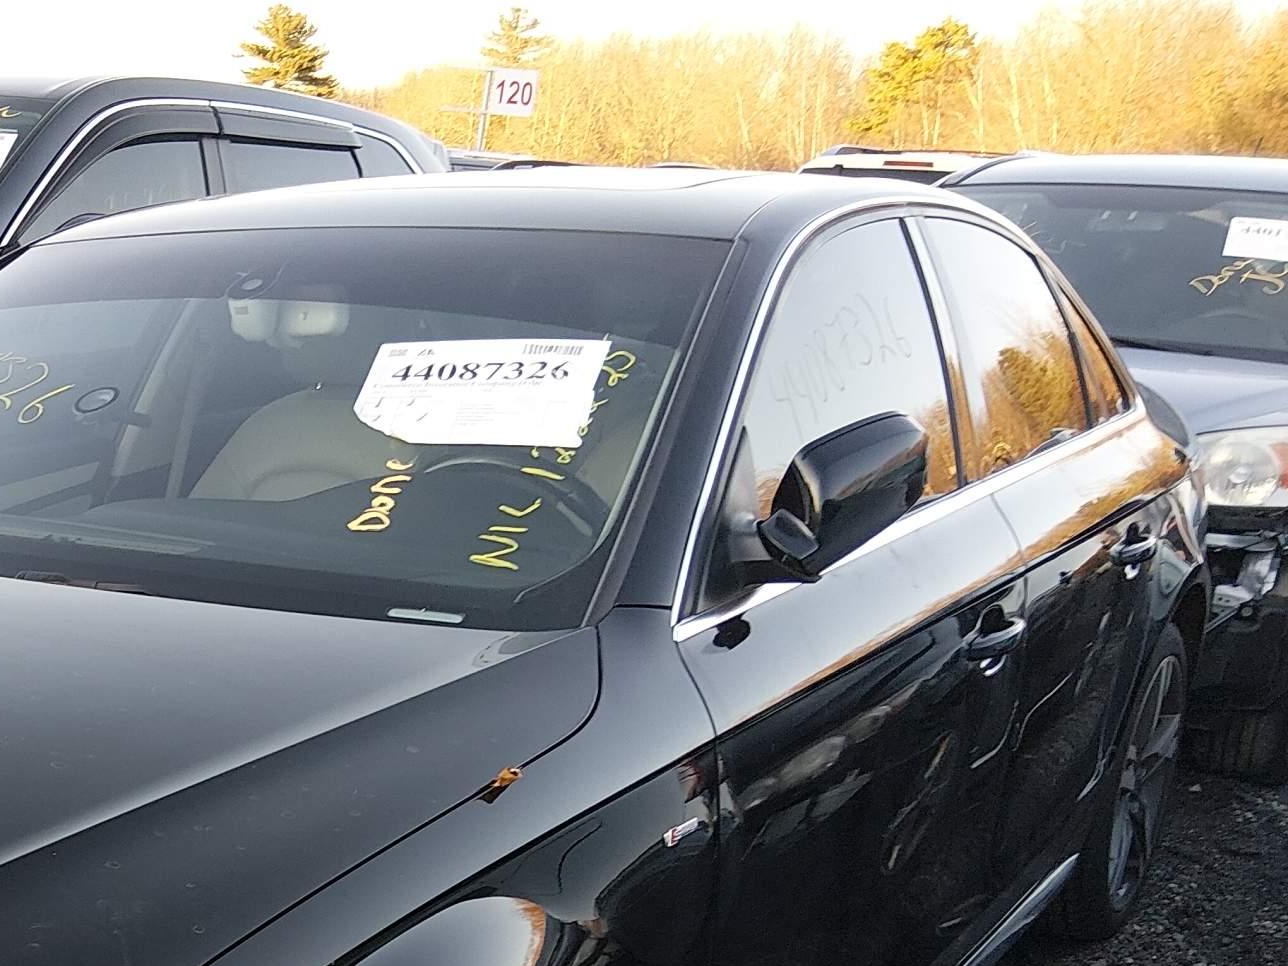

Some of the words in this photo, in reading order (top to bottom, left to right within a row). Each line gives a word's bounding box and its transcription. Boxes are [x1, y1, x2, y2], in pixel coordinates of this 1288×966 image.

[496, 79, 533, 106] 120
[392, 360, 571, 382] 44087326
[347, 458, 414, 532] Done
